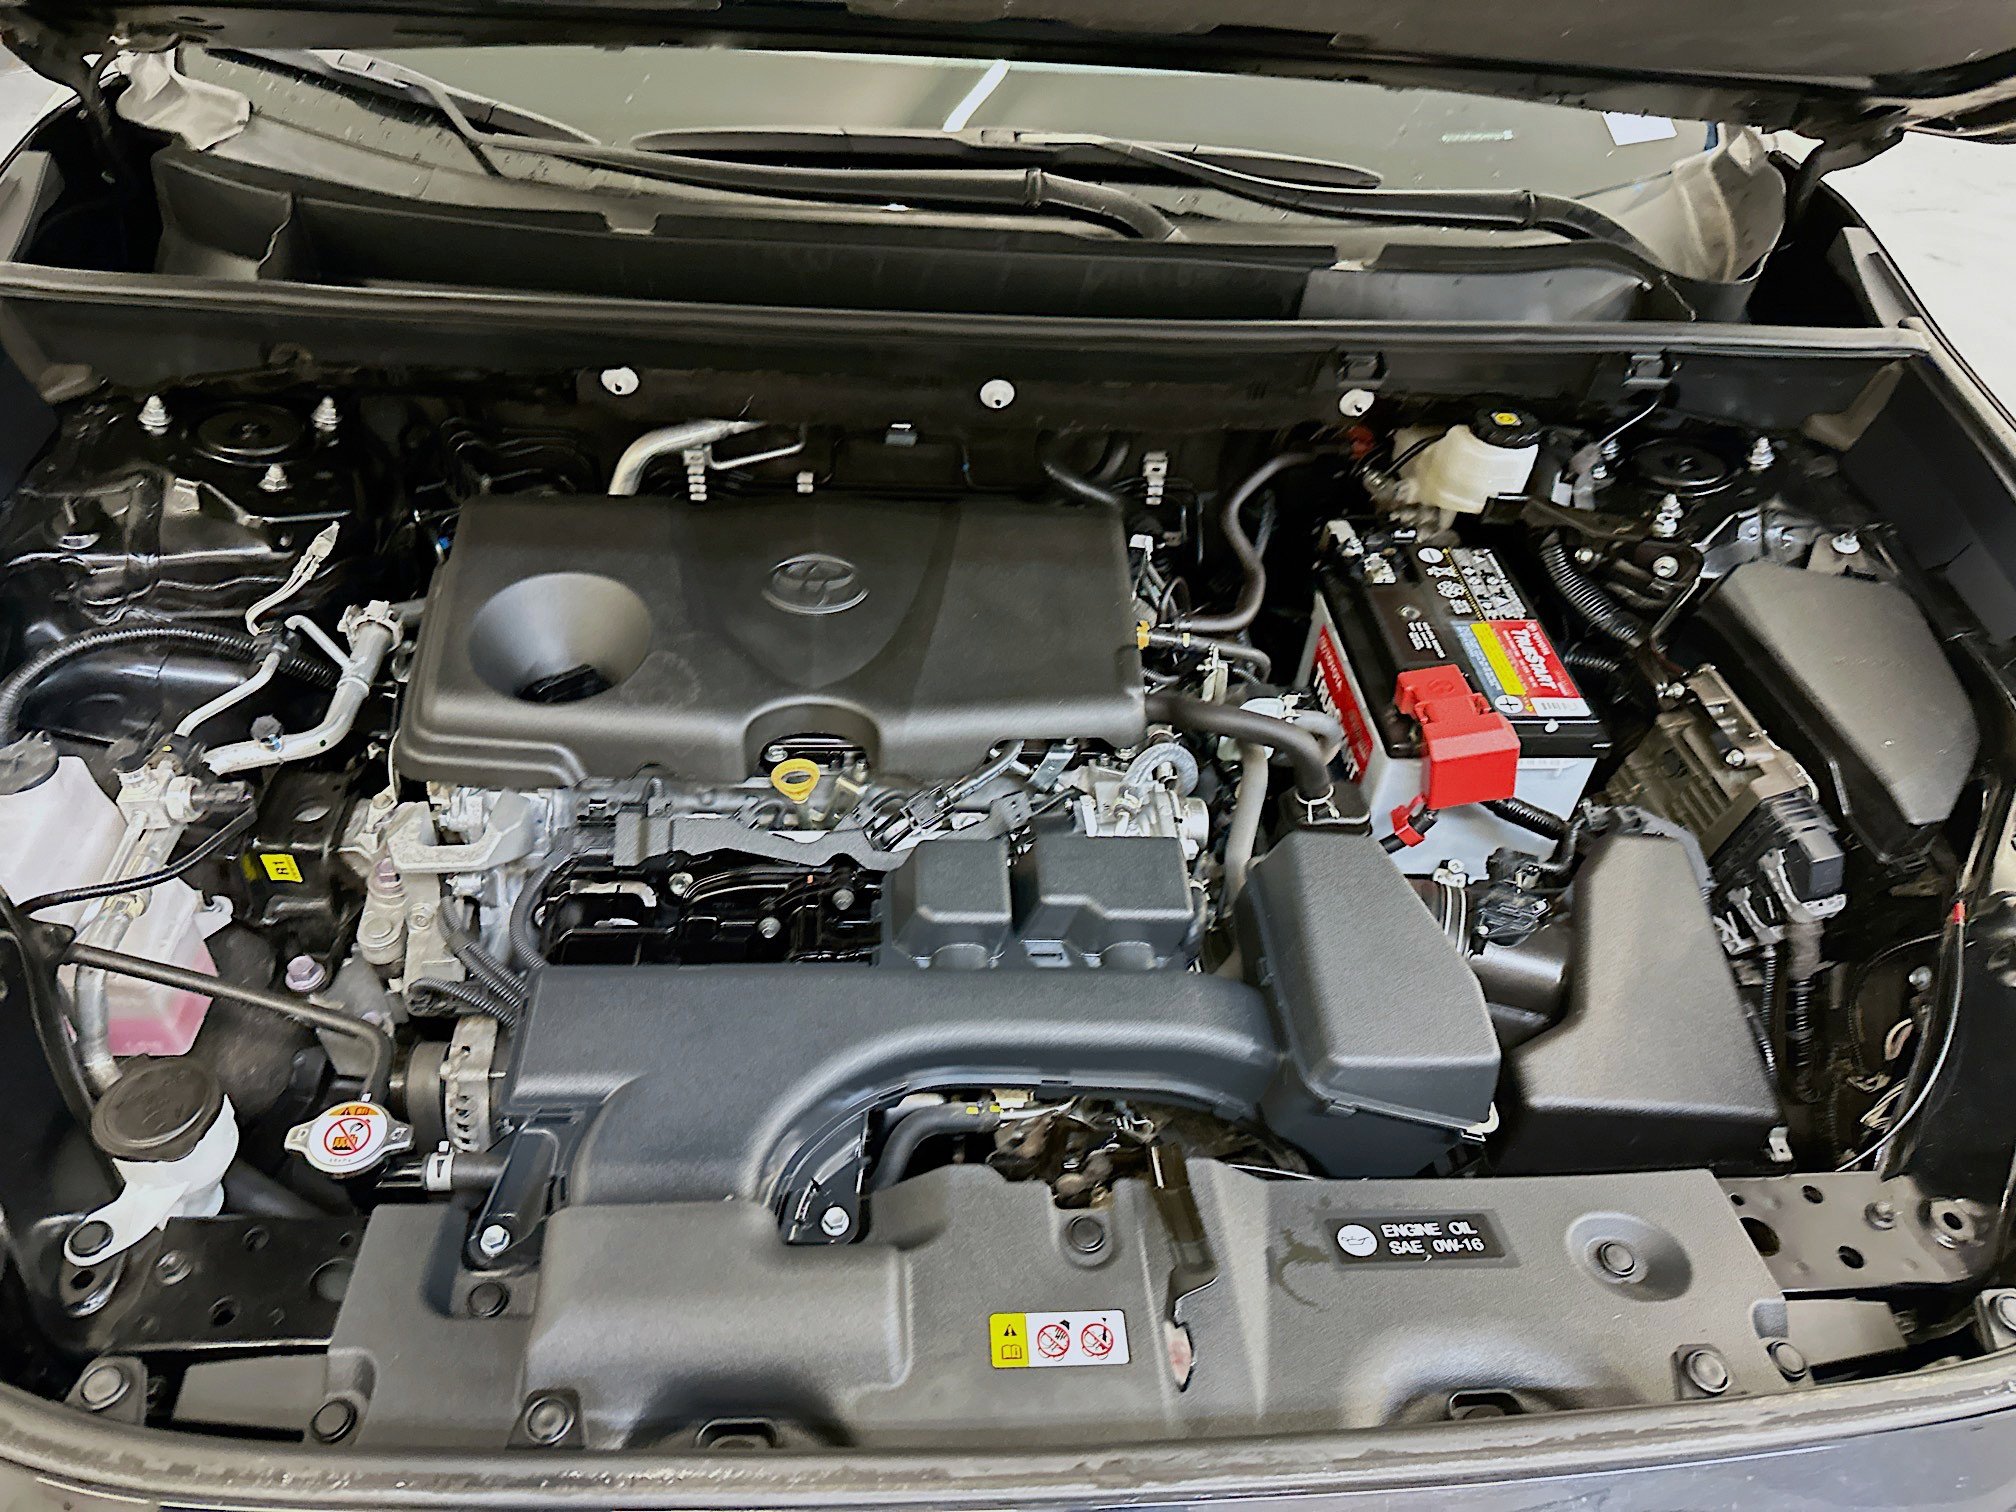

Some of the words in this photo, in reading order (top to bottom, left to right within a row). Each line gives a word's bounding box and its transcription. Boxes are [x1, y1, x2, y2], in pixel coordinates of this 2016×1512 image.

[1531, 631, 1551, 656] TOYOTA
[1380, 1222, 1443, 1238] ENGINE
[1448, 1221, 1478, 1235] OIL
[1388, 1239, 1426, 1255] SAE
[1432, 1237, 1485, 1253] 0W-16
